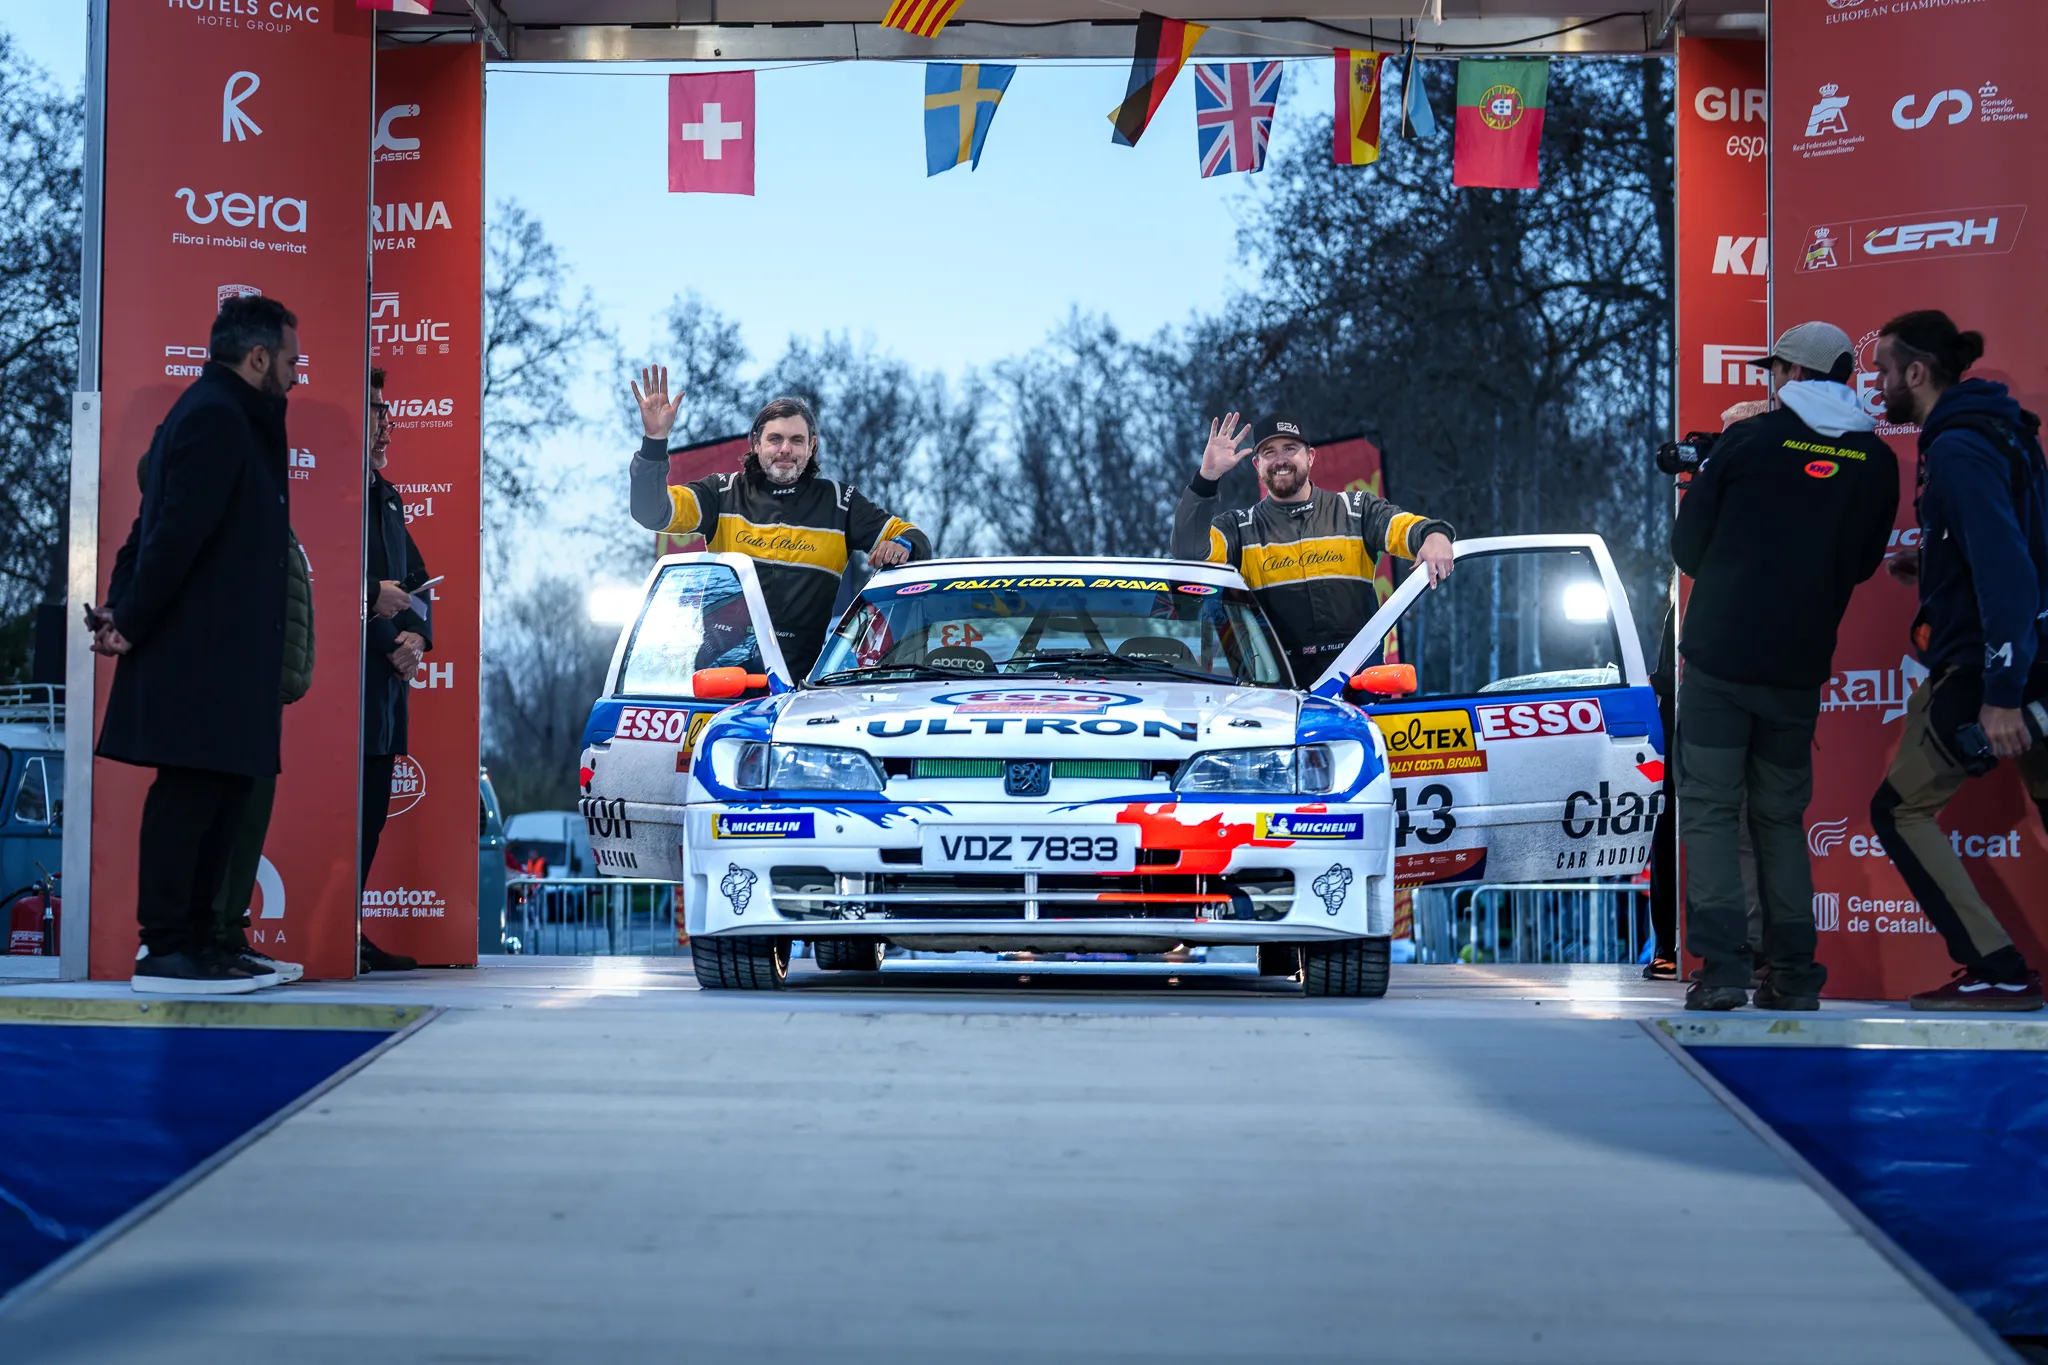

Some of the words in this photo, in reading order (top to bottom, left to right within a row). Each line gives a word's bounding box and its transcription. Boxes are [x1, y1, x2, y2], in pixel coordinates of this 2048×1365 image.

[269, 1, 319, 24] CMC
[1825, 5, 1888, 25] EUROPEAN
[197, 15, 239, 28] HOTEL
[247, 20, 292, 34] GROUP
[1981, 98, 2012, 107] Consejo
[1981, 106, 2014, 114] Superior
[1993, 113, 2028, 122] Deportes
[1726, 136, 1767, 162] esp
[1793, 143, 1806, 152] Real
[1811, 146, 1855, 157] Automovilismo
[174, 187, 307, 233] vera
[172, 232, 204, 246] Fibra
[206, 234, 211, 246] i
[213, 234, 247, 249] mòbil
[249, 237, 266, 250] de
[267, 239, 307, 254] veritat
[373, 237, 416, 251] WEAR
[1863, 217, 1998, 256] CERH
[388, 420, 419, 429] HAUST
[421, 420, 454, 428] SYSTEMS
[736, 530, 767, 548] Auto
[770, 535, 818, 553] Atelier
[1262, 556, 1296, 573] Auto
[1298, 550, 1345, 568] Atelier
[943, 578, 1017, 590] RALLY
[1017, 577, 1086, 588] COSTA
[1089, 579, 1170, 592] BRAVA
[967, 692, 1112, 703] ESSO
[615, 709, 686, 742] ESSO
[1479, 701, 1601, 740] ESSO
[867, 717, 1198, 742] ULTRON
[1389, 761, 1413, 773] ALLY
[1414, 758, 1445, 771] COSTA
[1446, 756, 1482, 769] BRAVA
[731, 821, 801, 832] MICHELIN
[1292, 821, 1357, 833] MICHELIN
[940, 835, 1012, 861] VDZ
[1021, 835, 1118, 861] 7833
[1556, 851, 1587, 870] CAR
[1596, 845, 1647, 867] AUDIO
[411, 907, 445, 917] ONLINE
[1847, 896, 1924, 913] General
[1847, 916, 1870, 933] de
